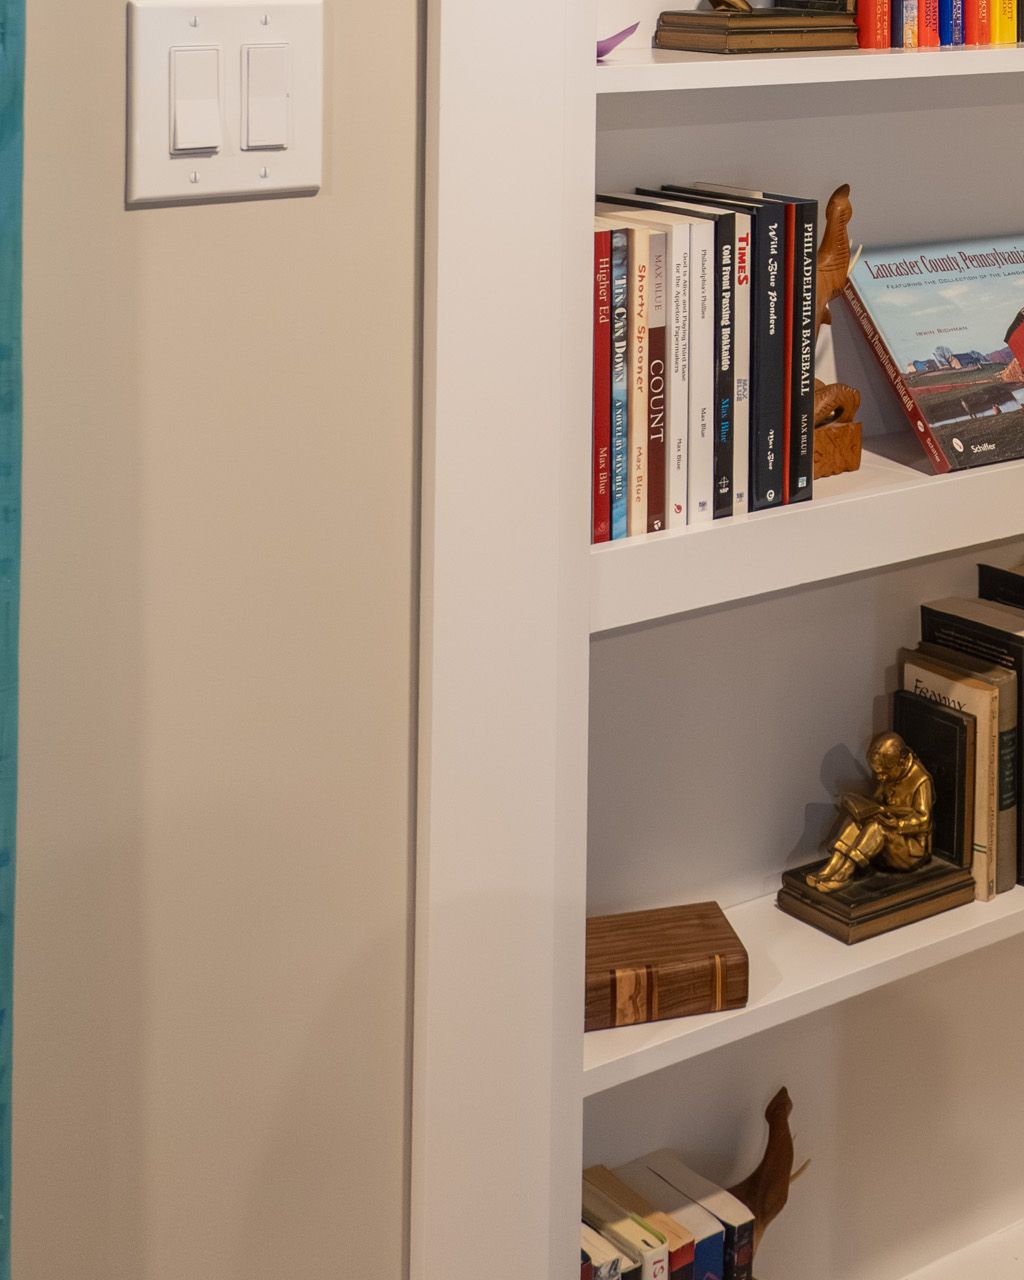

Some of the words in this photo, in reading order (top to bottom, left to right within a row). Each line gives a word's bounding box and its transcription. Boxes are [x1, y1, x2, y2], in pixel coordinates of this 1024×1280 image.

[769, 224, 778, 255] Wild
[722, 245, 731, 264] Cold
[738, 233, 749, 285] TIMES
[865, 256, 920, 279] Lancaster
[920, 252, 964, 277] County,
[598, 258, 610, 300] Higher
[722, 267, 731, 289] Front
[768, 258, 778, 287] Blue
[801, 223, 813, 325] PHILADELPHIA
[886, 281, 922, 290] FEATURING
[938, 275, 977, 284] COLLECTION
[615, 275, 626, 303] TIN
[636, 264, 646, 318] Shorty
[654, 279, 662, 311] BLUE
[600, 305, 609, 323] Ed
[615, 307, 626, 336] CAN
[720, 292, 731, 326] Passing
[768, 292, 778, 335] Ponders
[937, 326, 968, 334] RICHMAN
[614, 342, 626, 382] DOWN
[636, 325, 646, 393] Spooner
[721, 328, 731, 371] Hokkaido
[843, 283, 863, 317] Lancaster
[859, 310, 875, 343] County,
[893, 377, 914, 412] Postcards
[801, 330, 811, 396] BASEBALL
[650, 360, 664, 442] COUNT
[720, 399, 729, 419] Max
[616, 439, 623, 450] BY
[720, 421, 729, 442] Blue
[599, 447, 607, 469] Max
[926, 437, 942, 463] Schiffer
[971, 442, 996, 454] Schiffer
[599, 473, 607, 495] Blue
